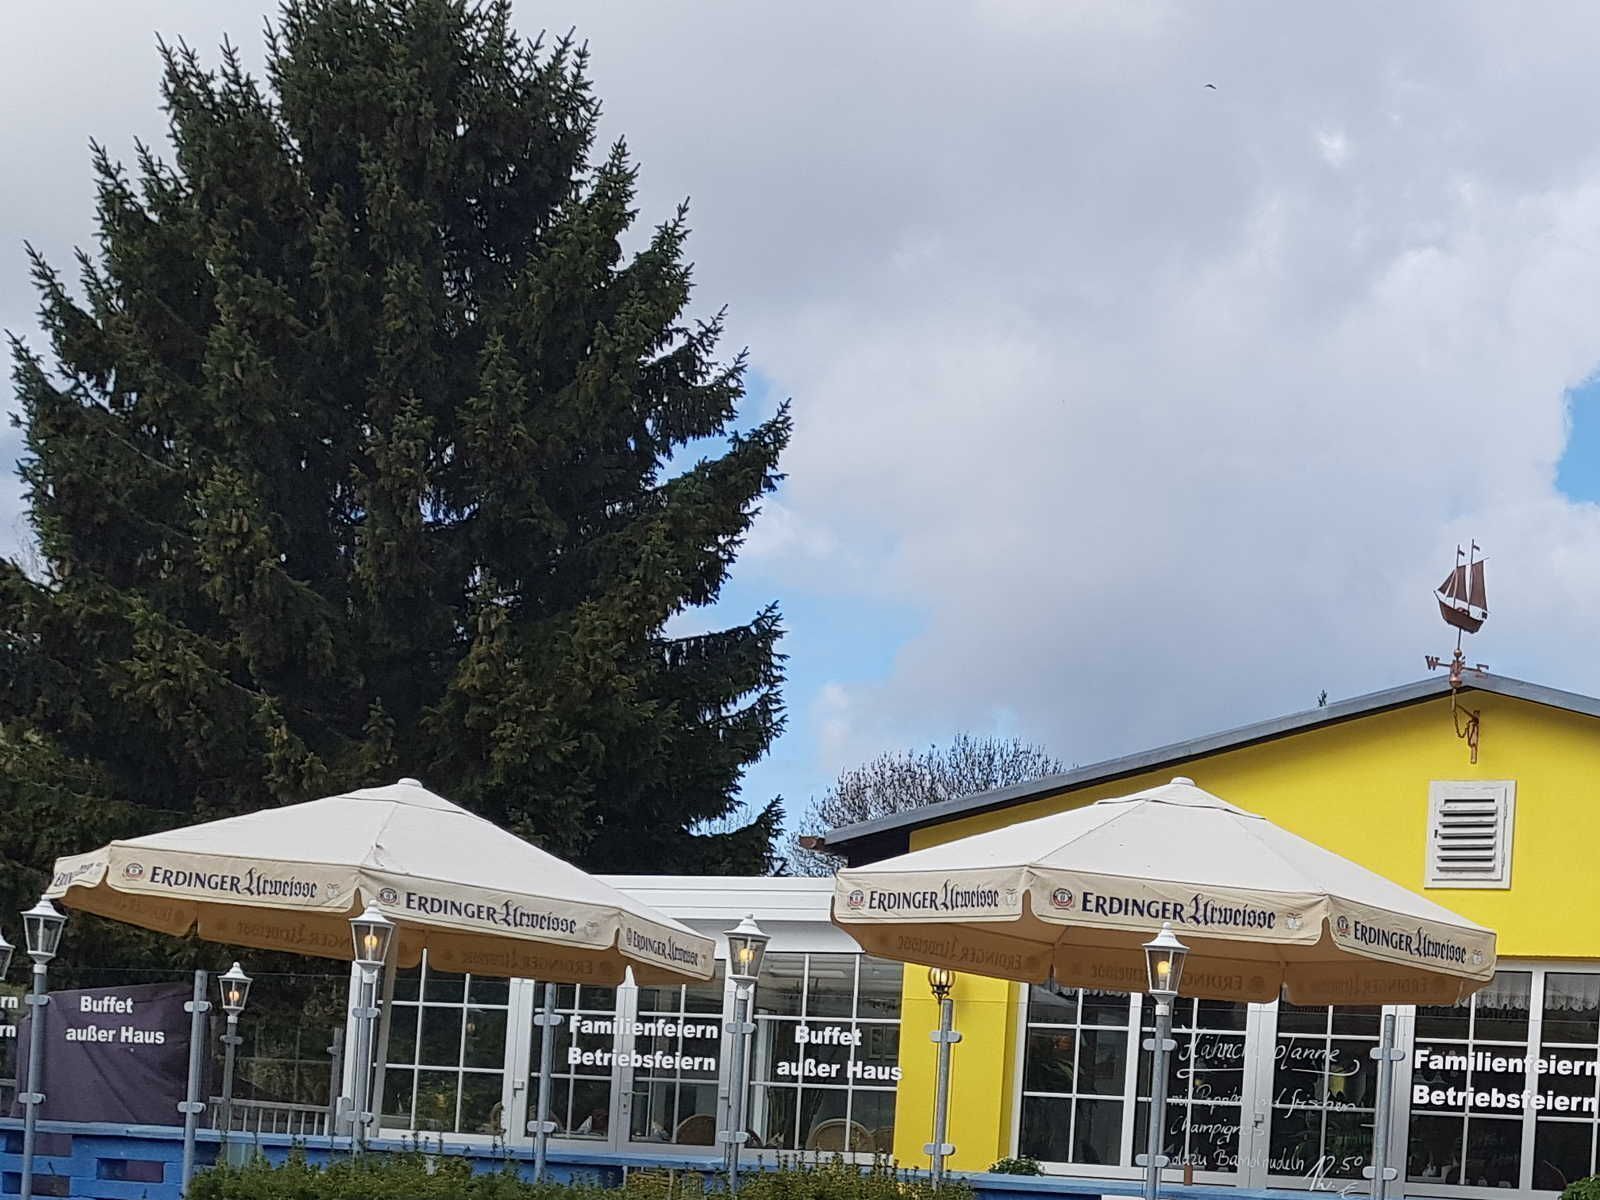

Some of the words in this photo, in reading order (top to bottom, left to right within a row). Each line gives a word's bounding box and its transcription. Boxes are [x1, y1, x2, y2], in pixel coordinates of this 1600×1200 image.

[150, 865, 240, 894] ERDINGER
[405, 892, 499, 922] ERDINGER
[868, 890, 940, 912] ERDINGER
[1081, 891, 1186, 923] ERDINGER
[633, 931, 667, 960] ERDINGER
[1354, 920, 1413, 951] ERDINGER
[80, 995, 133, 1014] Buffet
[65, 1025, 116, 1042] außer
[120, 1026, 165, 1044] Haus
[568, 1015, 718, 1039] Familienfeiern
[794, 1025, 862, 1046] Buffet
[567, 1047, 716, 1071] Betriebsfeiern
[776, 1058, 840, 1079] außer
[846, 1060, 903, 1081] Haus
[1414, 1049, 1600, 1076] Familienfeiern
[1412, 1084, 1598, 1112] Betriebsfeiern
